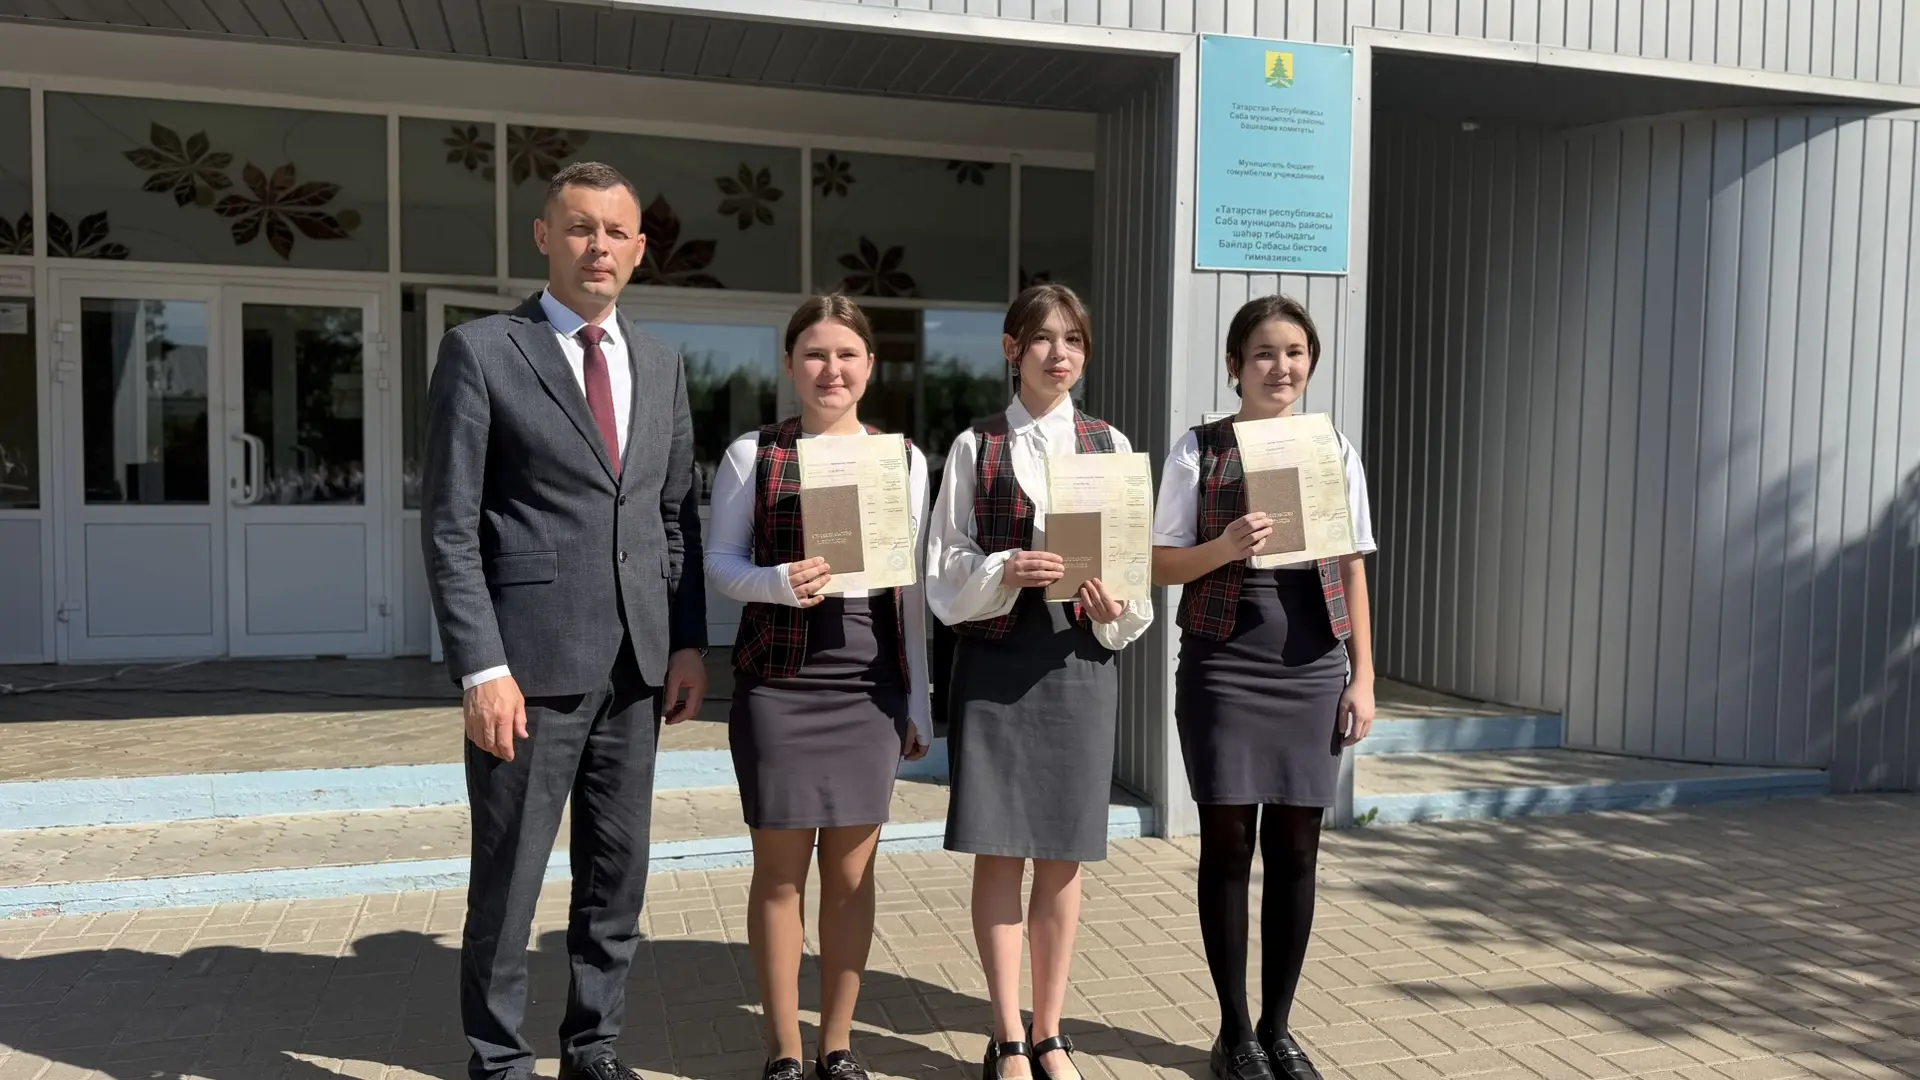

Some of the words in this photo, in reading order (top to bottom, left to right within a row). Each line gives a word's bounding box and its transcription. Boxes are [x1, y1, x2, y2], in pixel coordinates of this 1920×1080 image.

[1231, 102, 1270, 112] Татарстан
[1271, 105, 1324, 116] Республикасы
[1229, 112, 1249, 121] Саба
[1250, 115, 1296, 124] муниципаль
[1297, 117, 1325, 126] районы
[1279, 126, 1315, 134] комитеты
[1238, 159, 1285, 169] Муниципаль
[1286, 162, 1315, 171] бюджет
[1215, 204, 1267, 216] «Татарстан
[1269, 209, 1333, 219] республикасы
[1215, 216, 1238, 225] Саба
[1240, 219, 1297, 229] муниципаль
[1298, 220, 1333, 230] районы
[1232, 229, 1263, 239] шәһәр
[1264, 230, 1316, 241] тибындагы
[1218, 239, 1253, 250] Байлар
[1255, 241, 1291, 251] Сабасы
[1292, 243, 1328, 252] бистәсе
